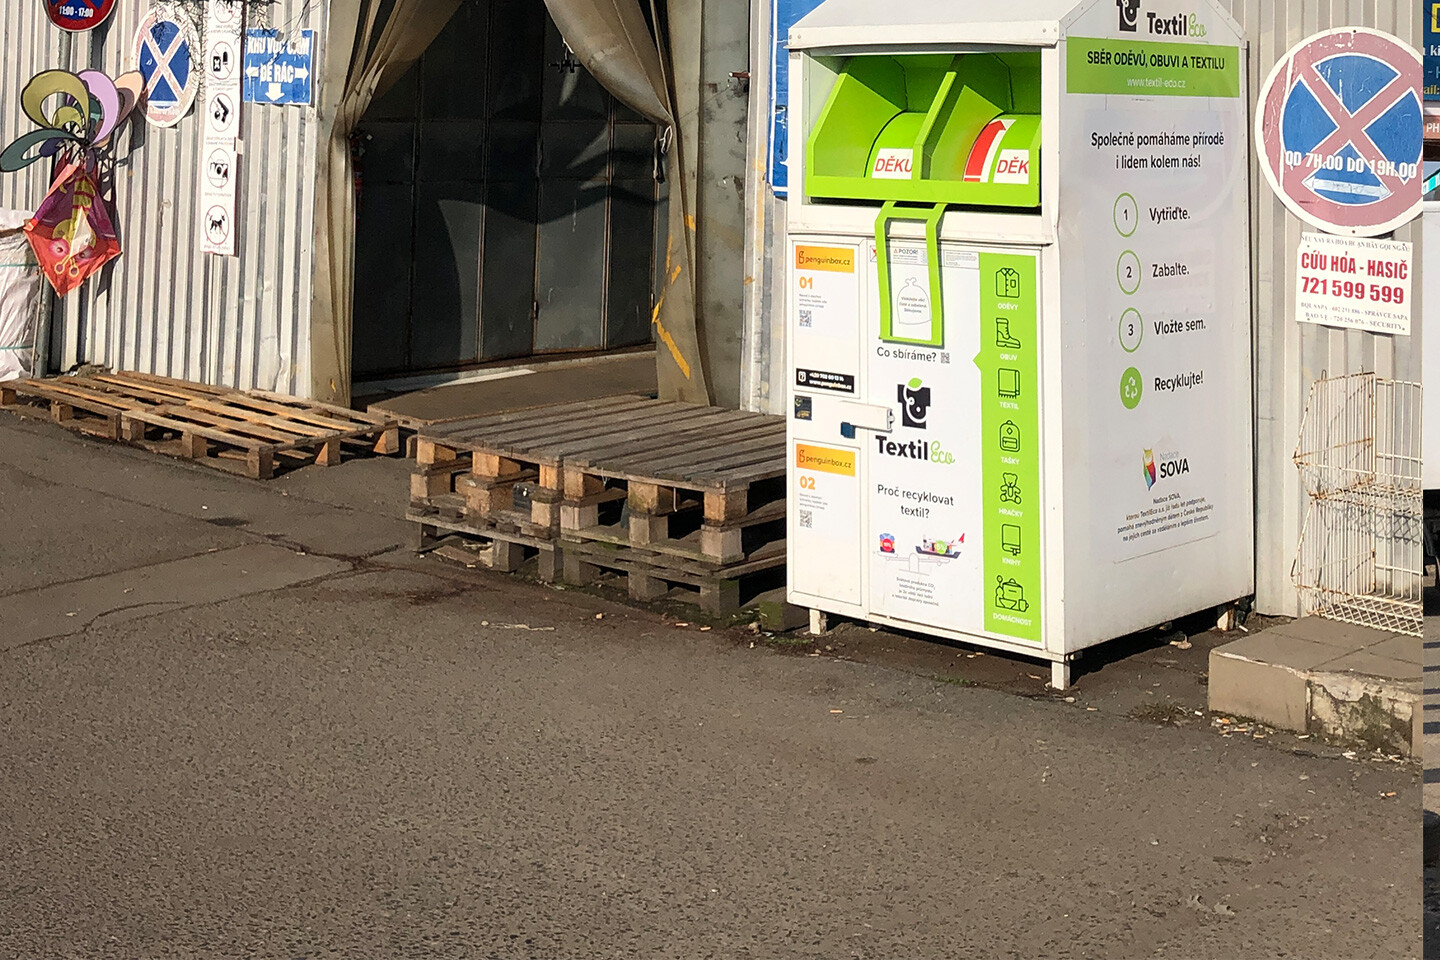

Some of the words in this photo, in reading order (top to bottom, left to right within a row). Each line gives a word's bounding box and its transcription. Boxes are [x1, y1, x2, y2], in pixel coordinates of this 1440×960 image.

[1147, 12, 1187, 36] Textil
[1087, 49, 1112, 65] SBĚR
[1114, 50, 1148, 68] ODĚVŮ,
[1150, 54, 1180, 68] OBUVI
[1190, 56, 1225, 70] TEXTILU
[1127, 77, 1186, 88] www.textil-eco.cz
[1091, 132, 1134, 149] Společně
[1137, 132, 1190, 149] pomáháme
[1192, 132, 1225, 148] přírodě
[997, 157, 1029, 174] DĚK
[1121, 155, 1148, 169] lidem
[1150, 155, 1180, 168] kolem
[1182, 153, 1201, 168] nás!
[1346, 157, 1364, 173] DO
[805, 255, 850, 266] penguinbox.cz
[1301, 250, 1327, 270] CỨU
[1367, 259, 1408, 280] HASIČ
[1152, 262, 1190, 278] Zabalte.
[799, 276, 813, 290] 01
[1301, 276, 1327, 295] 721
[1332, 280, 1365, 299] 599
[1370, 284, 1404, 304] 599
[1154, 319, 1183, 335] Vložte
[1185, 319, 1206, 332] sem.
[876, 346, 890, 357] Co
[892, 348, 937, 363] sbíráme?
[1154, 370, 1204, 392] Recyklujte!
[875, 435, 929, 461] Textil
[930, 440, 955, 465] Eco
[1160, 458, 1190, 479] SOVA
[877, 484, 899, 497] Proč
[902, 490, 954, 506] recyklovat
[900, 504, 930, 519] textil?
